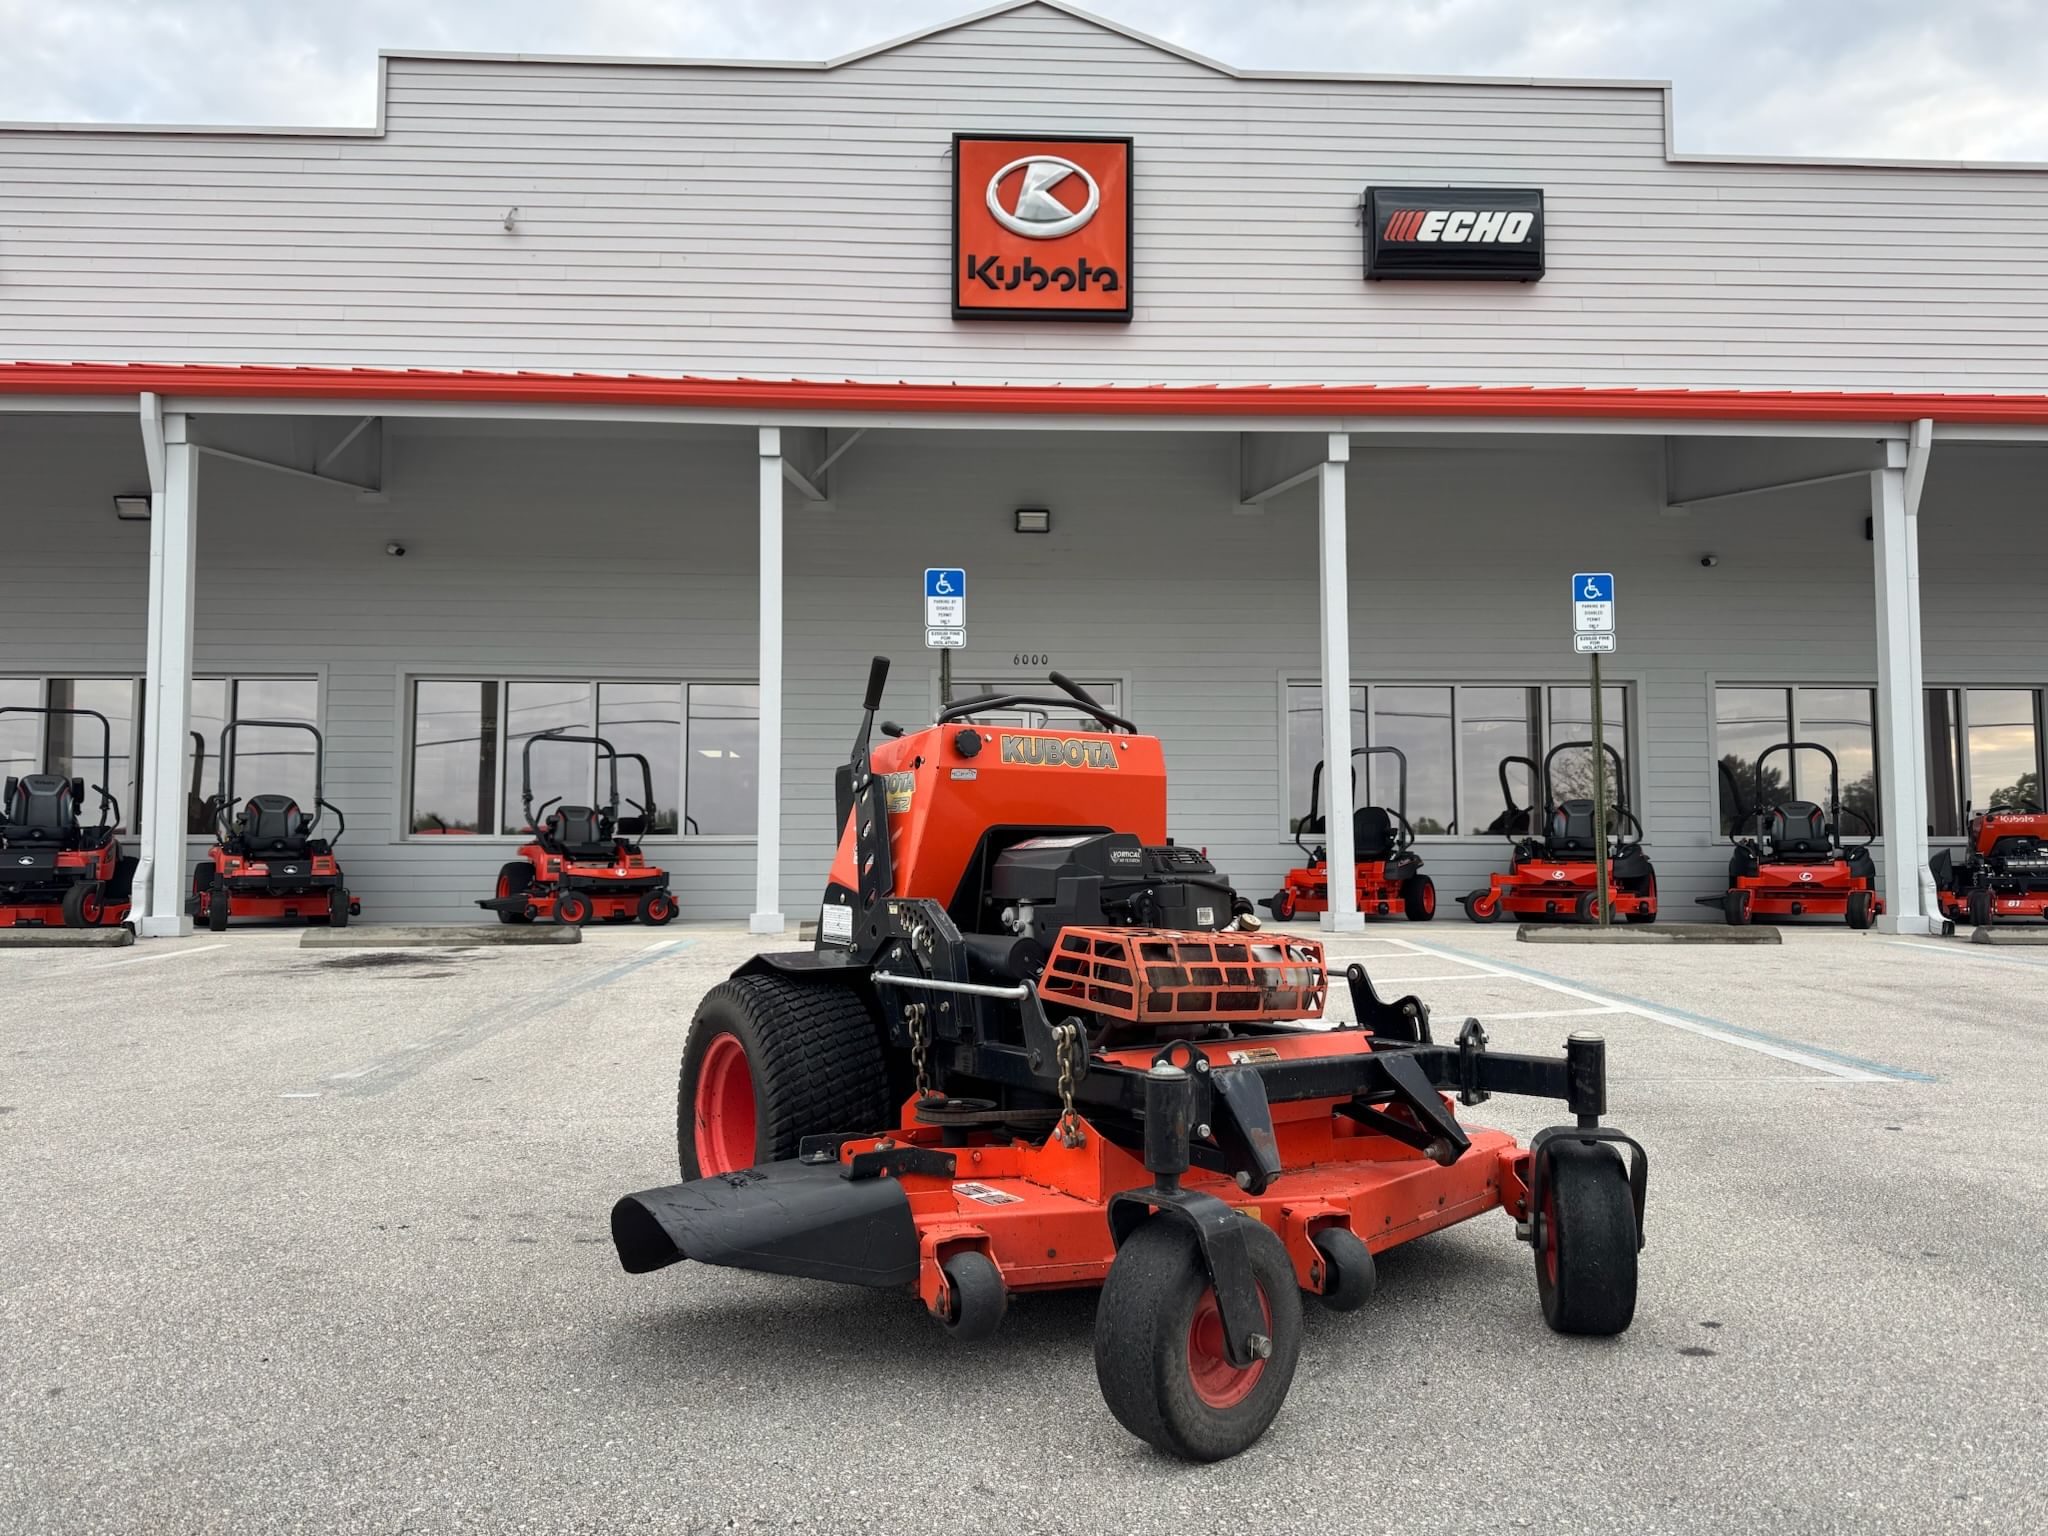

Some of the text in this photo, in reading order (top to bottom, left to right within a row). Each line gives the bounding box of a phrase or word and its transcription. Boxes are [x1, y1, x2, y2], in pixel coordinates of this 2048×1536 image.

[1416, 210, 1535, 243] ECHO
[967, 254, 1118, 292] Kubota
[1013, 654, 1048, 665] 6000
[1001, 735, 1118, 768] KUBOTA
[2000, 815, 2034, 823] Kubota
